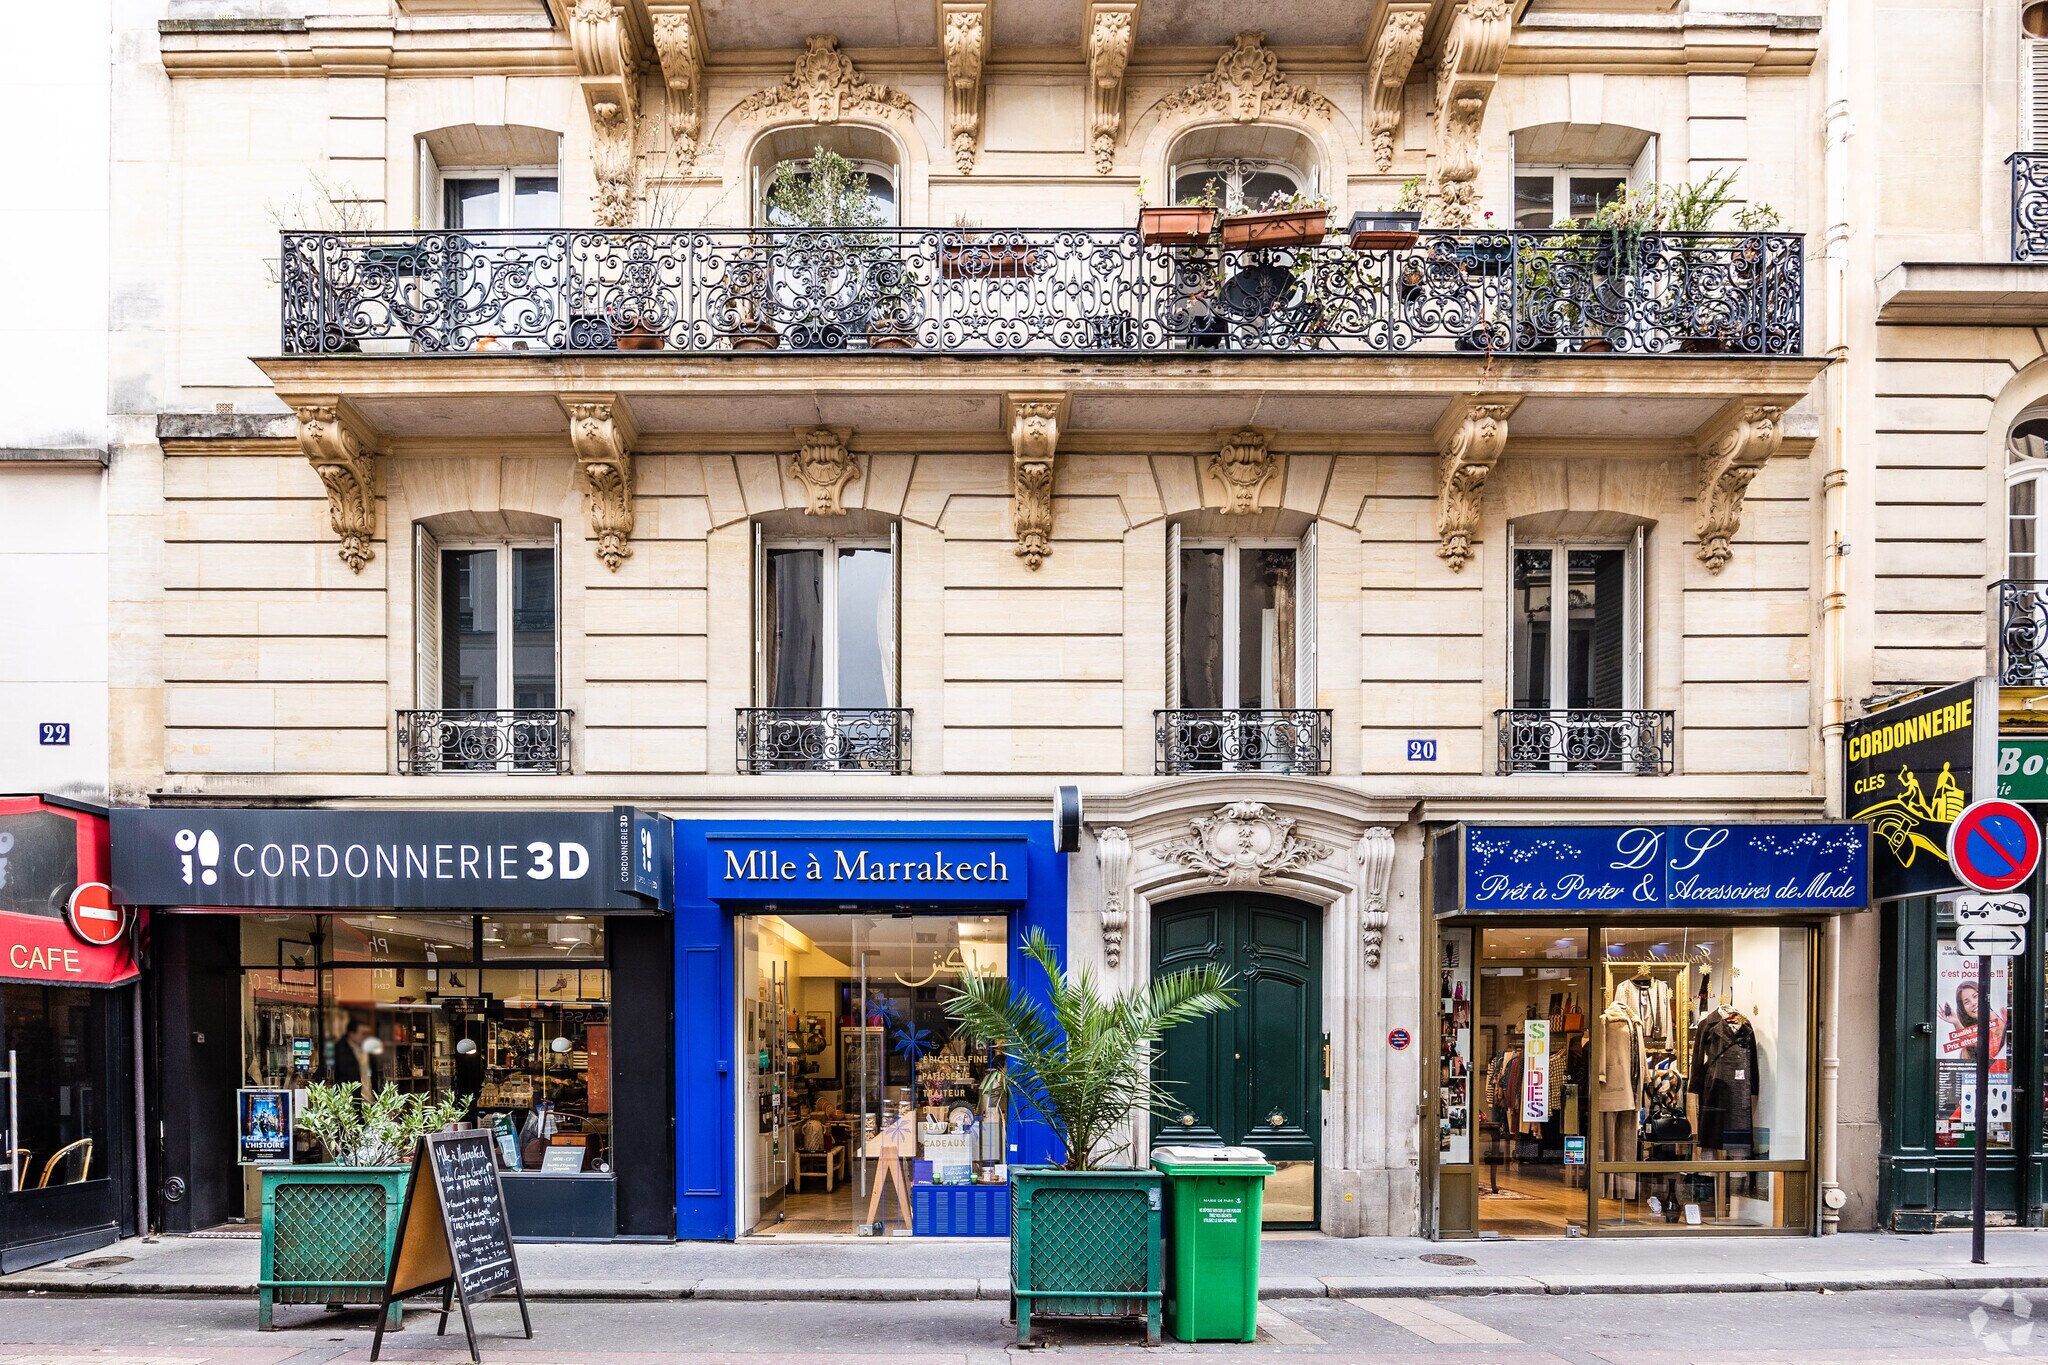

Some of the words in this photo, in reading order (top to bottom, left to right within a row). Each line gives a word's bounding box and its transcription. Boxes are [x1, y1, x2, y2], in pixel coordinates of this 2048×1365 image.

[43, 724, 66, 743] 22
[1849, 699, 1972, 761] CORDONNERIE
[1411, 741, 1434, 759] 20
[1854, 774, 1885, 795] CLES
[619, 815, 628, 828] 3D
[620, 828, 629, 882] CORDONNERIE
[1610, 828, 1665, 869] D
[233, 843, 518, 880] CORDONNERIE
[526, 841, 591, 880] 3D
[724, 850, 797, 880] Mlle
[806, 852, 823, 880] à
[833, 850, 1009, 881] Marrakech
[1477, 873, 1533, 901] Prêt
[1534, 880, 1549, 899] à
[1552, 874, 1625, 901] Porter
[1632, 873, 1659, 902] &
[1670, 874, 1772, 900] Accessoires
[1776, 875, 1798, 899] de
[1797, 872, 1855, 899] Mode
[10, 944, 82, 973] CAFE
[1963, 960, 1979, 970] Oui
[1941, 969, 1960, 978] c'est
[968, 1055, 988, 1064] FINE
[1527, 1023, 1545, 1118] SOLDES
[923, 1089, 966, 1098] TRAITEUR
[924, 1139, 966, 1148] CADEAUX
